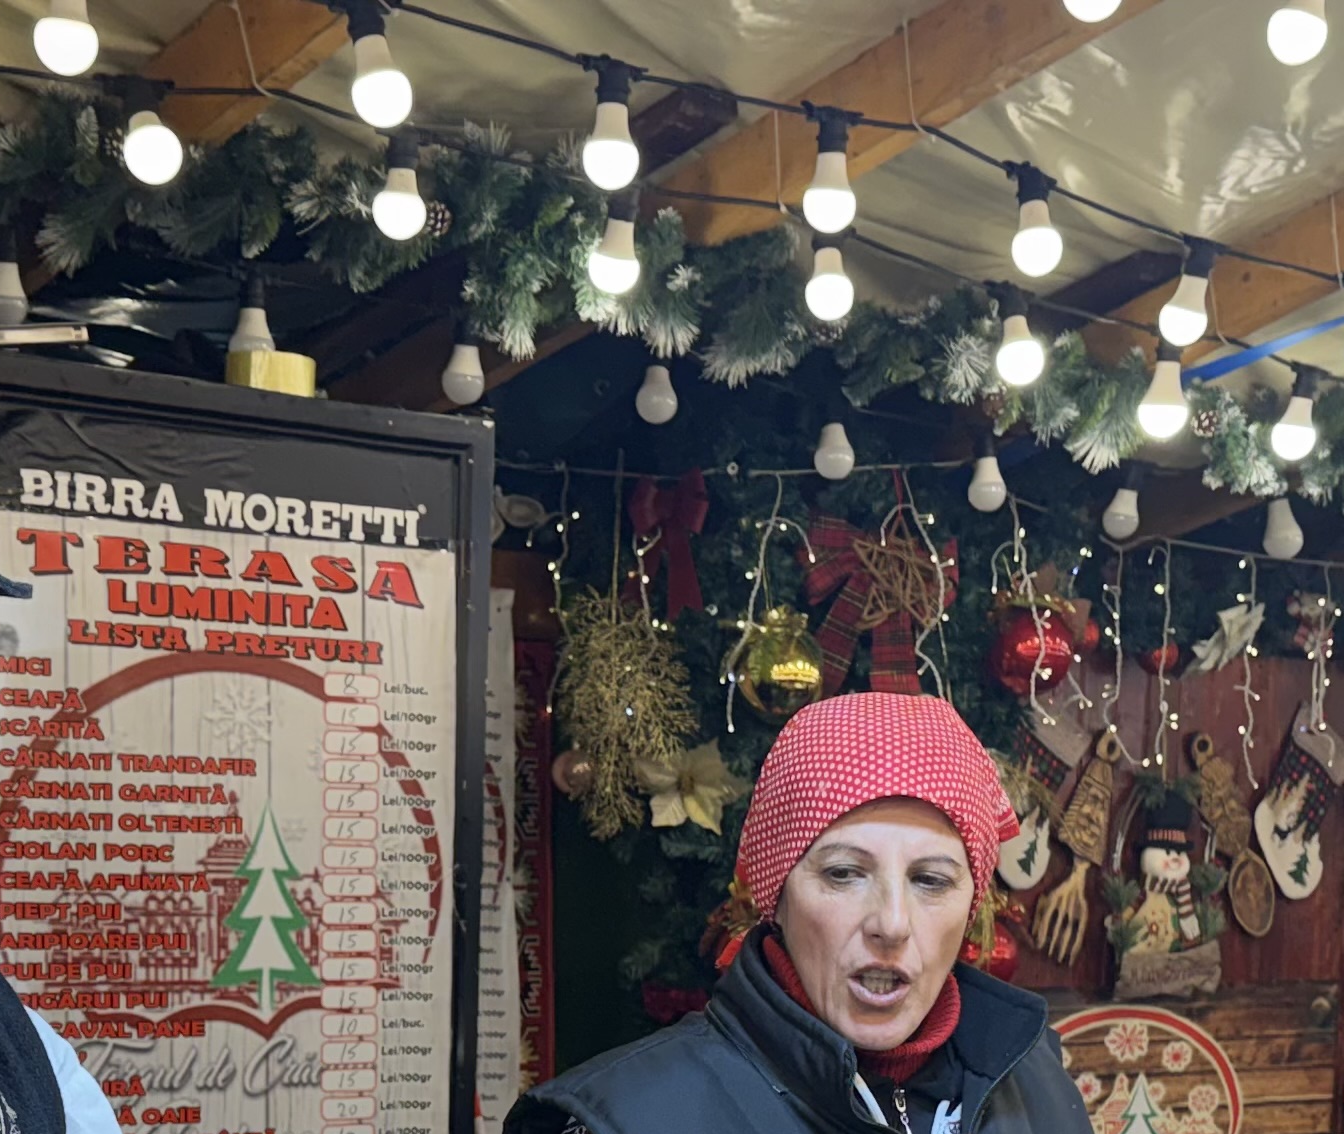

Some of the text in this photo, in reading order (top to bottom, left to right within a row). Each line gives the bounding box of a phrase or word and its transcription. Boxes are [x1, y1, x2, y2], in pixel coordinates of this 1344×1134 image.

[19, 467, 421, 546] BIRRA MORETTI
[16, 527, 424, 608] TERASA
[106, 578, 347, 631] LUMINITA
[67, 618, 383, 664] LISTA PRETURI
[384, 710, 437, 724] Lei/100gr
[118, 753, 257, 776] TRANDAFIR
[103, 844, 174, 862] PORC
[0, 901, 122, 921] PIEPT PUI
[146, 933, 188, 951] PUI
[88, 962, 132, 981] PUI
[17, 988, 169, 1010] RIGĂRUI PUI
[136, 1021, 206, 1039] PANE
[142, 1105, 201, 1126] OAIE
